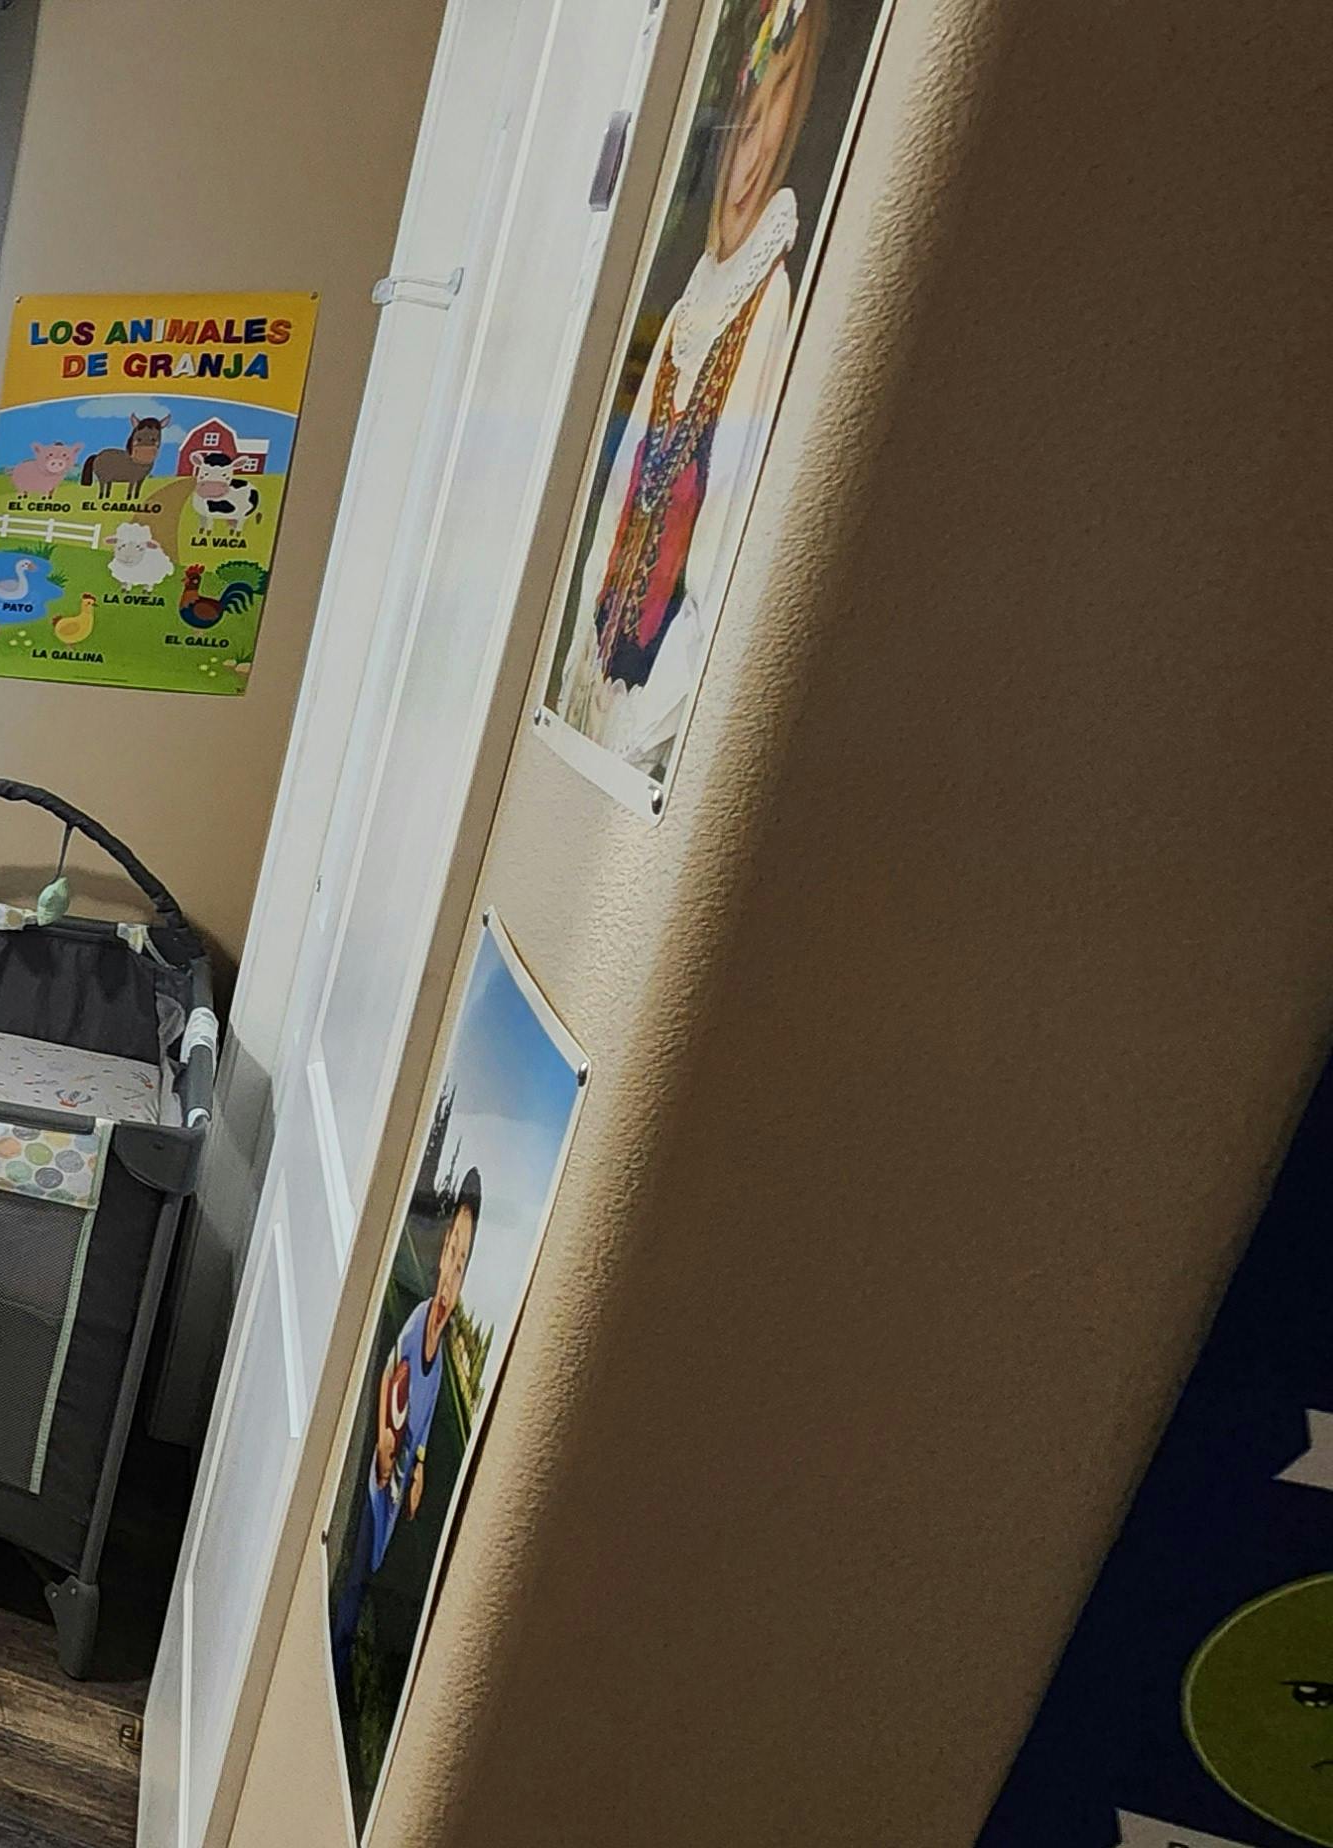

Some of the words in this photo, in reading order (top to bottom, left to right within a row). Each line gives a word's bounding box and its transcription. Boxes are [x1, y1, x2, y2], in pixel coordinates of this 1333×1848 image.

[30, 321, 96, 346] LOS
[104, 318, 292, 346] ANIMALES
[62, 352, 108, 379] DE
[123, 352, 270, 380] GRANJA
[8, 502, 24, 511] EL
[26, 502, 71, 513] CERDO
[82, 502, 97, 511] EL
[99, 502, 161, 514] CABALLO
[191, 536, 208, 547] LA
[211, 538, 247, 549] VACA
[103, 594, 119, 604] LA
[121, 595, 165, 607] OVEJA
[3, 602, 33, 613] PATO
[165, 635, 182, 646] EL
[185, 636, 230, 649] GALLO
[32, 649, 48, 660] LA
[51, 651, 104, 663] GALLINA
